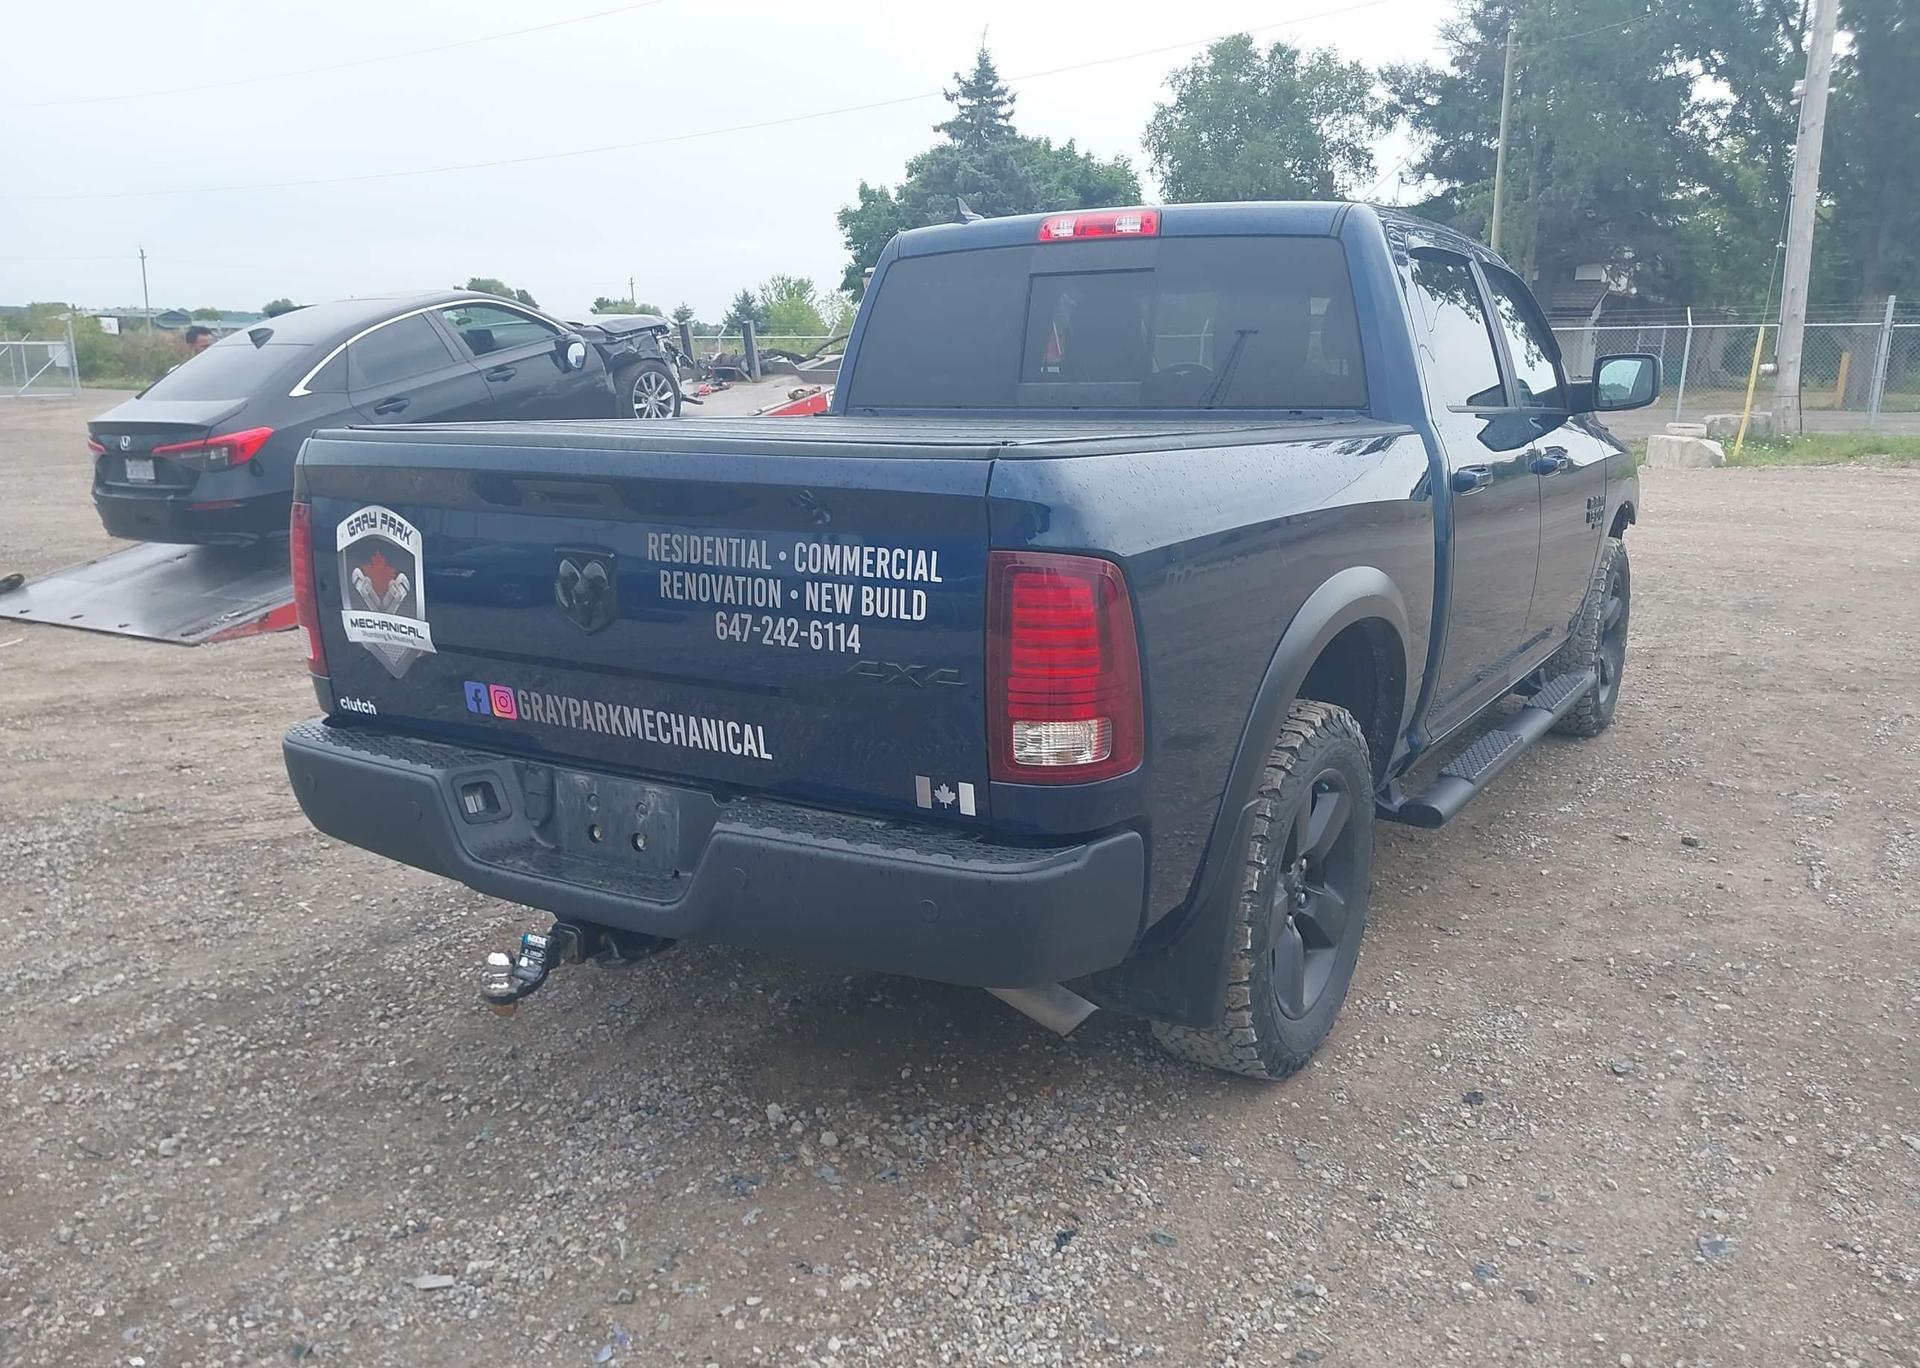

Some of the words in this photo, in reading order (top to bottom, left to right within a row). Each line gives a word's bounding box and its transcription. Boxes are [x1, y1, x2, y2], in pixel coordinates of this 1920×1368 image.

[347, 511, 377, 537] GRAY
[380, 512, 413, 545] PARK
[647, 532, 772, 570] RESIDENTIAL
[794, 542, 943, 583] COMMERCIAL
[659, 570, 781, 609] RENOVATION
[805, 581, 854, 615] NEW
[861, 586, 928, 621] BUILD
[350, 618, 425, 640] MECHANICAL
[715, 611, 861, 654] 647-242-6114
[340, 697, 377, 716] clutch
[516, 689, 773, 760] GRAYPARKMECHANICAL
